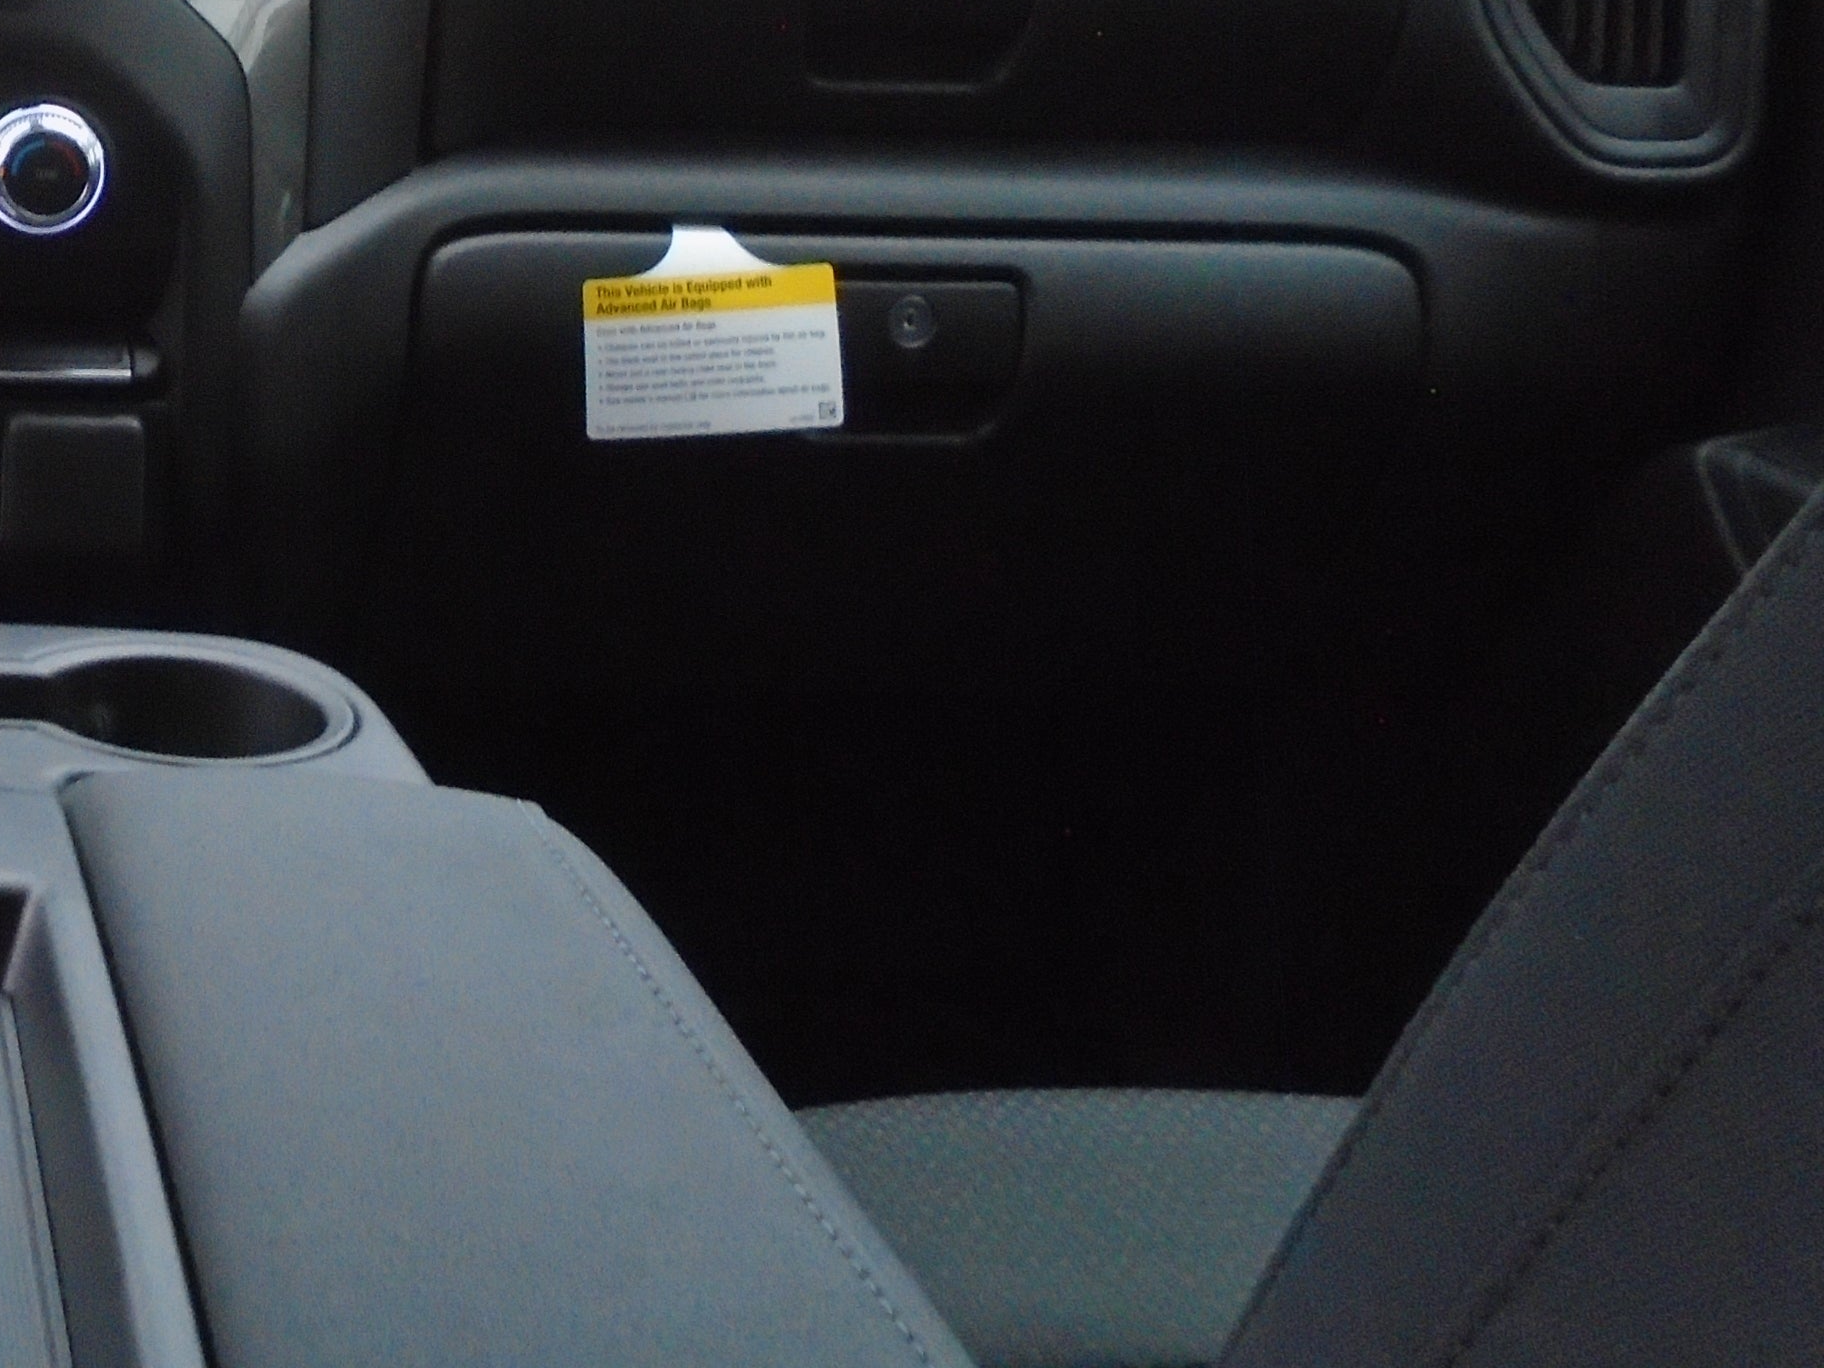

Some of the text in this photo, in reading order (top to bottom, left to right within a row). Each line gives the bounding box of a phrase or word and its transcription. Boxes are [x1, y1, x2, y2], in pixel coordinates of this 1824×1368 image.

[596, 275, 773, 298] This Vehicle is Equipped with
[596, 296, 712, 316] Advanced Air Bags
